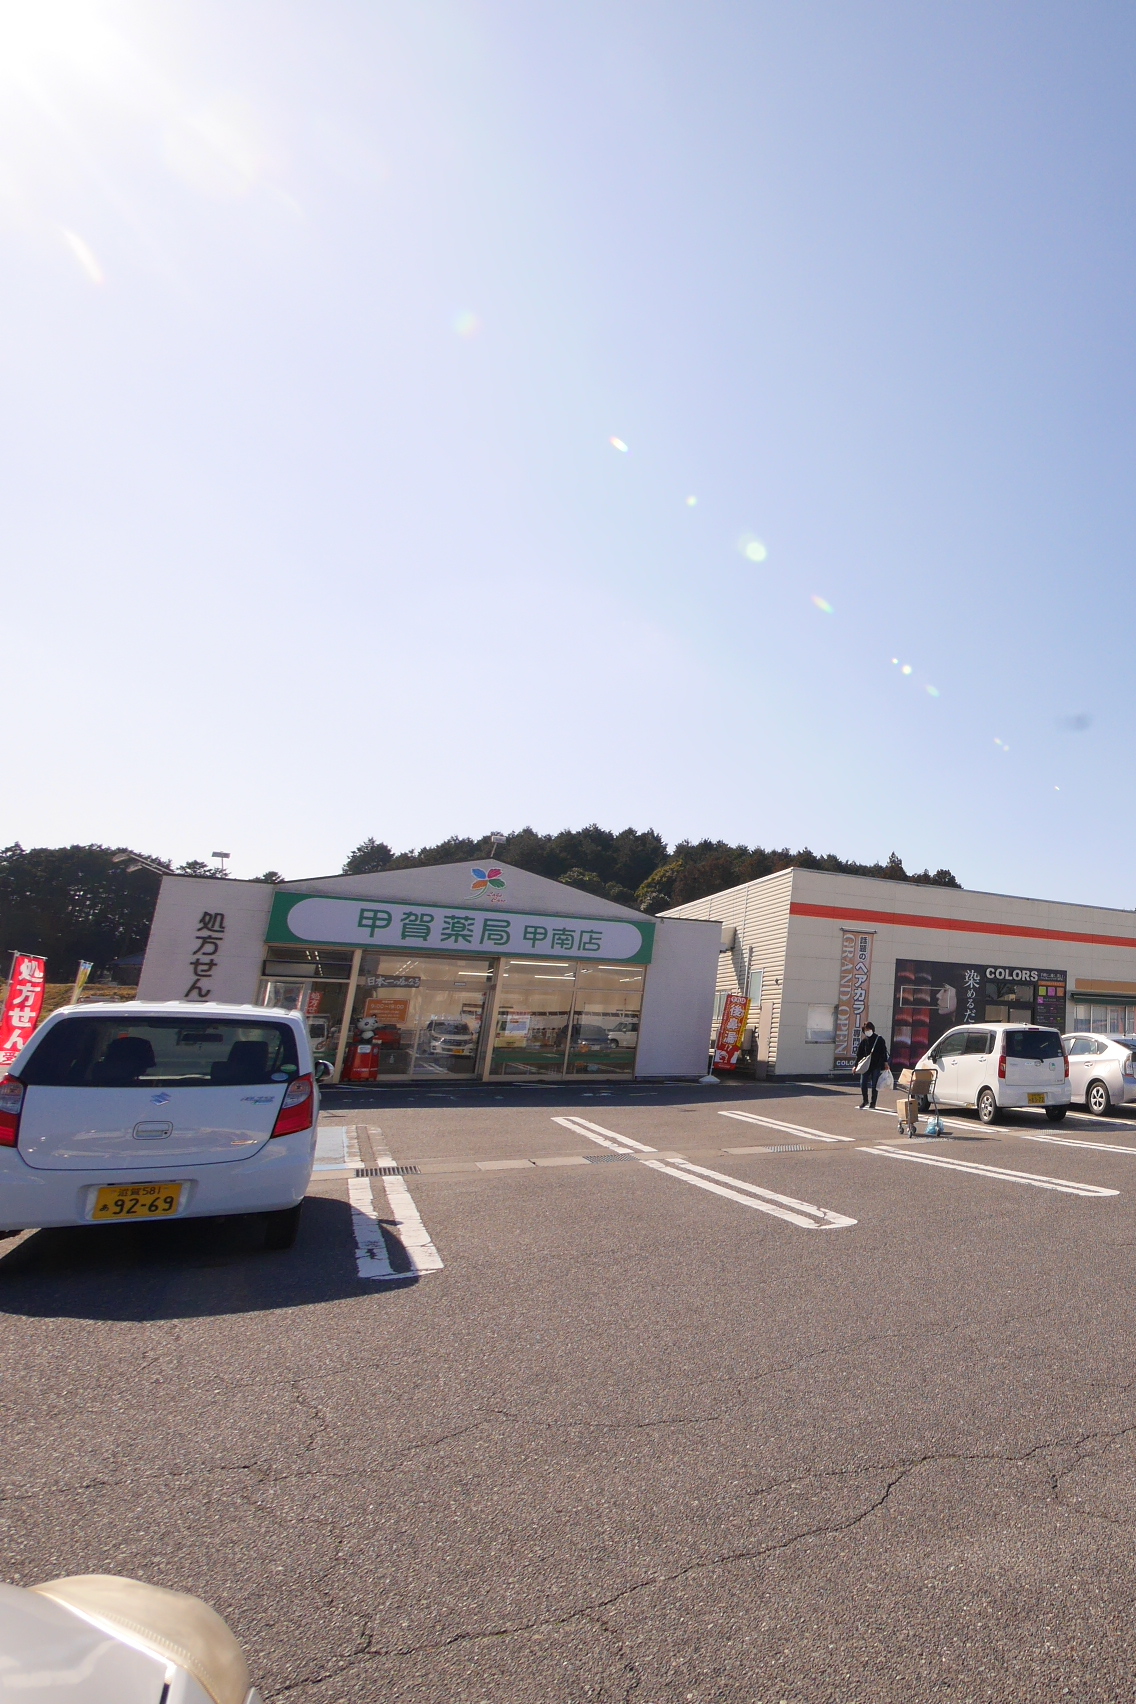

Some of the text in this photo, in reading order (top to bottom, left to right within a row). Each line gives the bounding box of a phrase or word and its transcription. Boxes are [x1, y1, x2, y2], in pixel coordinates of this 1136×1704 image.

[357, 908, 603, 952] 甲賀薬局 甲南店
[835, 933, 856, 1056] GRAND OPEN
[985, 967, 1039, 981] COLORS
[3, 958, 44, 1050] 処方せん
[112, 1196, 175, 1215] 92-69
